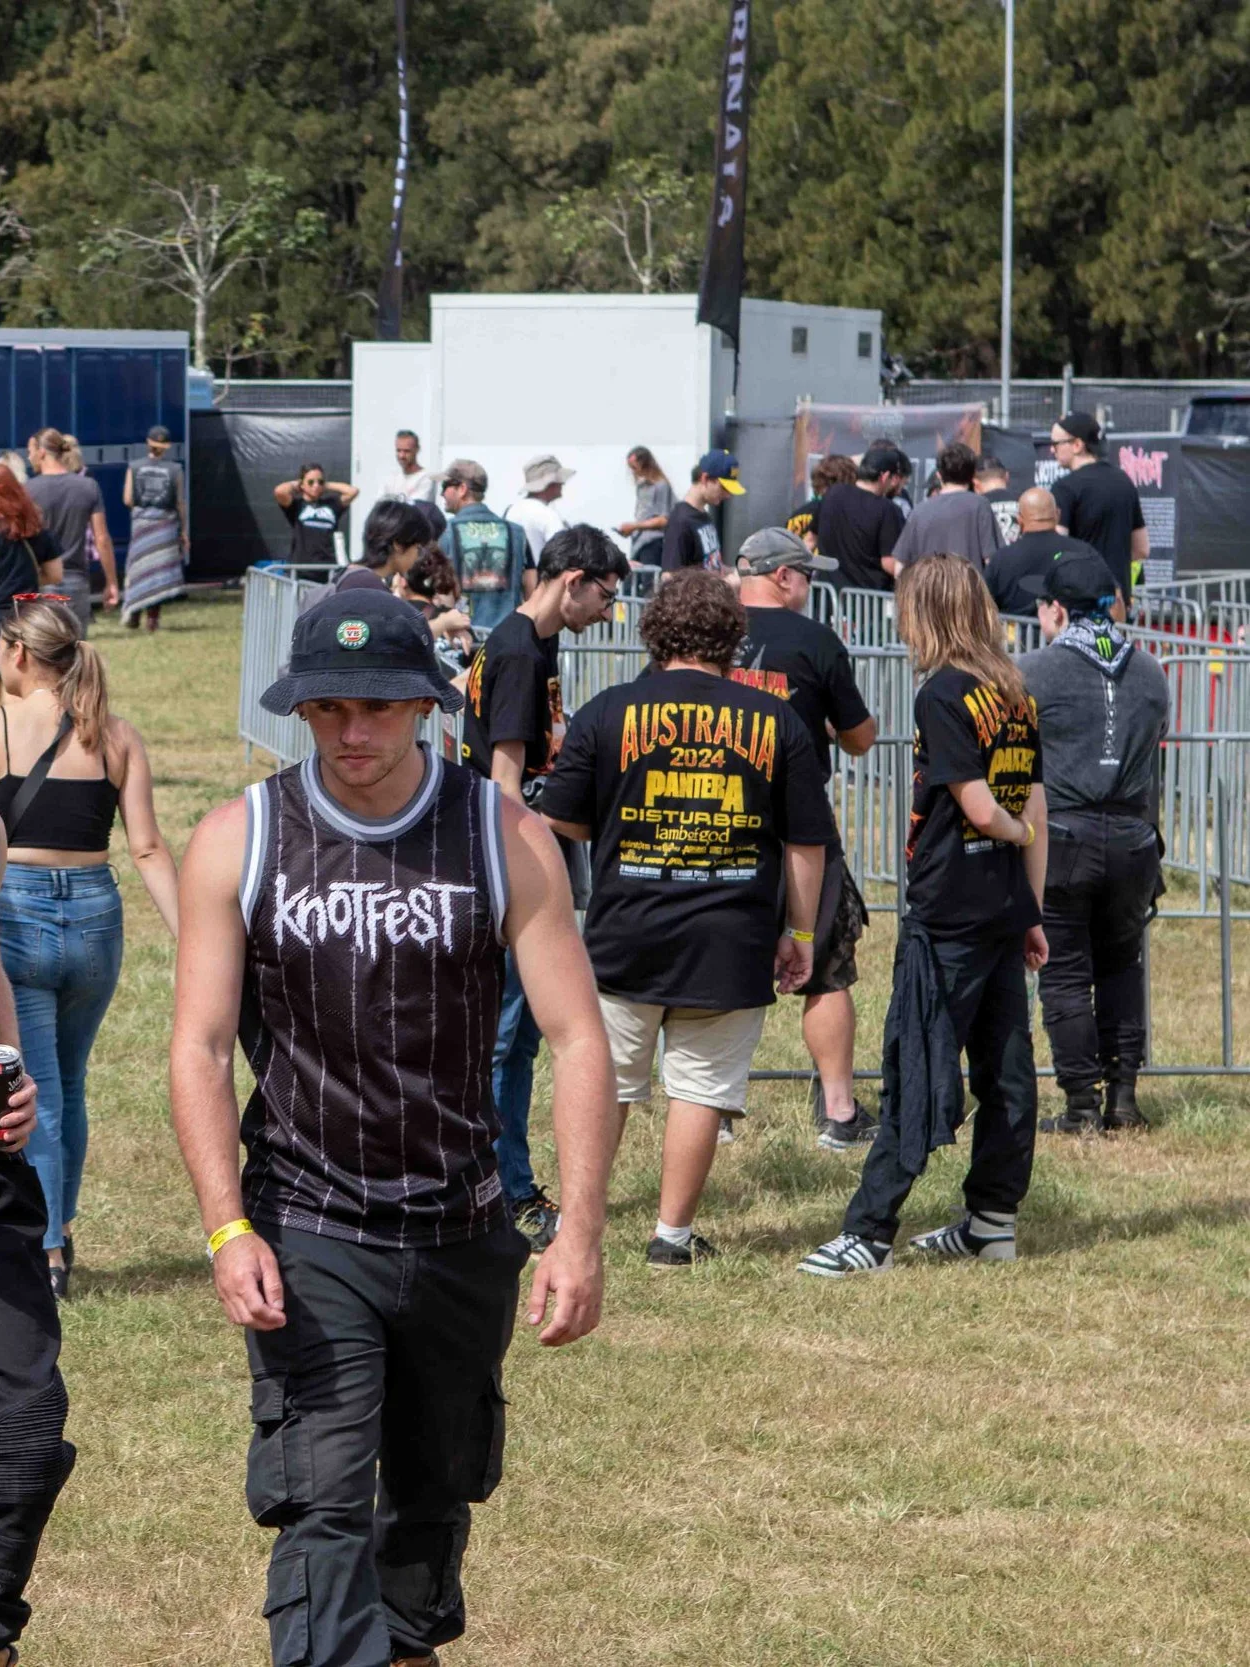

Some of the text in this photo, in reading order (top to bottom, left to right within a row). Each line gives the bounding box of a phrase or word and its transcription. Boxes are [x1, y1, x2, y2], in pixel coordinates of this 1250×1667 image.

[620, 702, 777, 783] AUSTRALIA
[669, 746, 727, 769] 2024
[644, 770, 745, 813] PANTERA
[620, 806, 762, 829] DISTURBED
